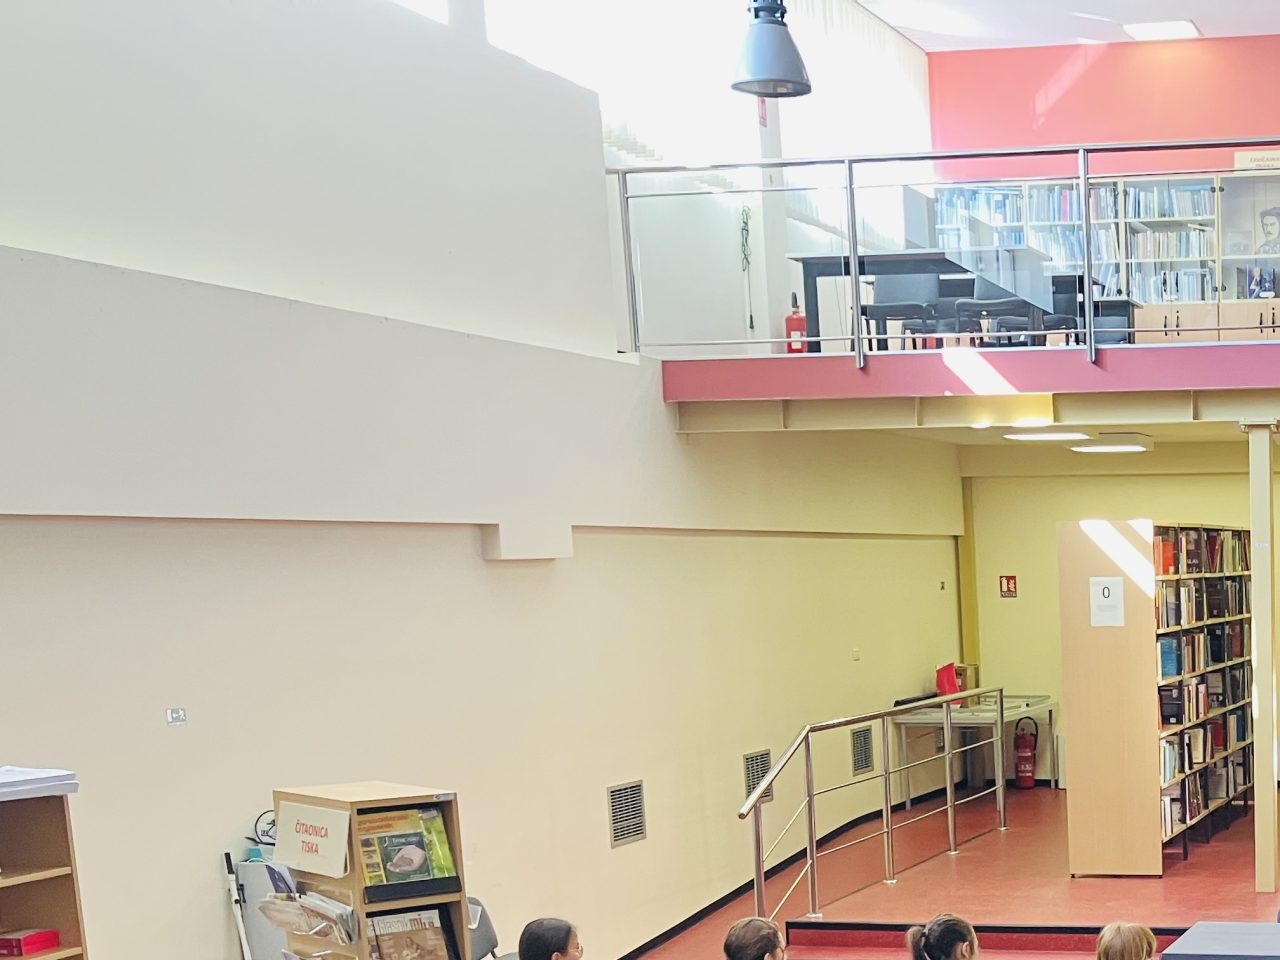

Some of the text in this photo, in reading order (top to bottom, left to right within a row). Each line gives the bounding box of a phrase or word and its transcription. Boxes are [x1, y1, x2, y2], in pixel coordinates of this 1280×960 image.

[1102, 587, 1111, 599] 0
[295, 820, 328, 838] ČITAONICA
[301, 841, 319, 855] TISKA
